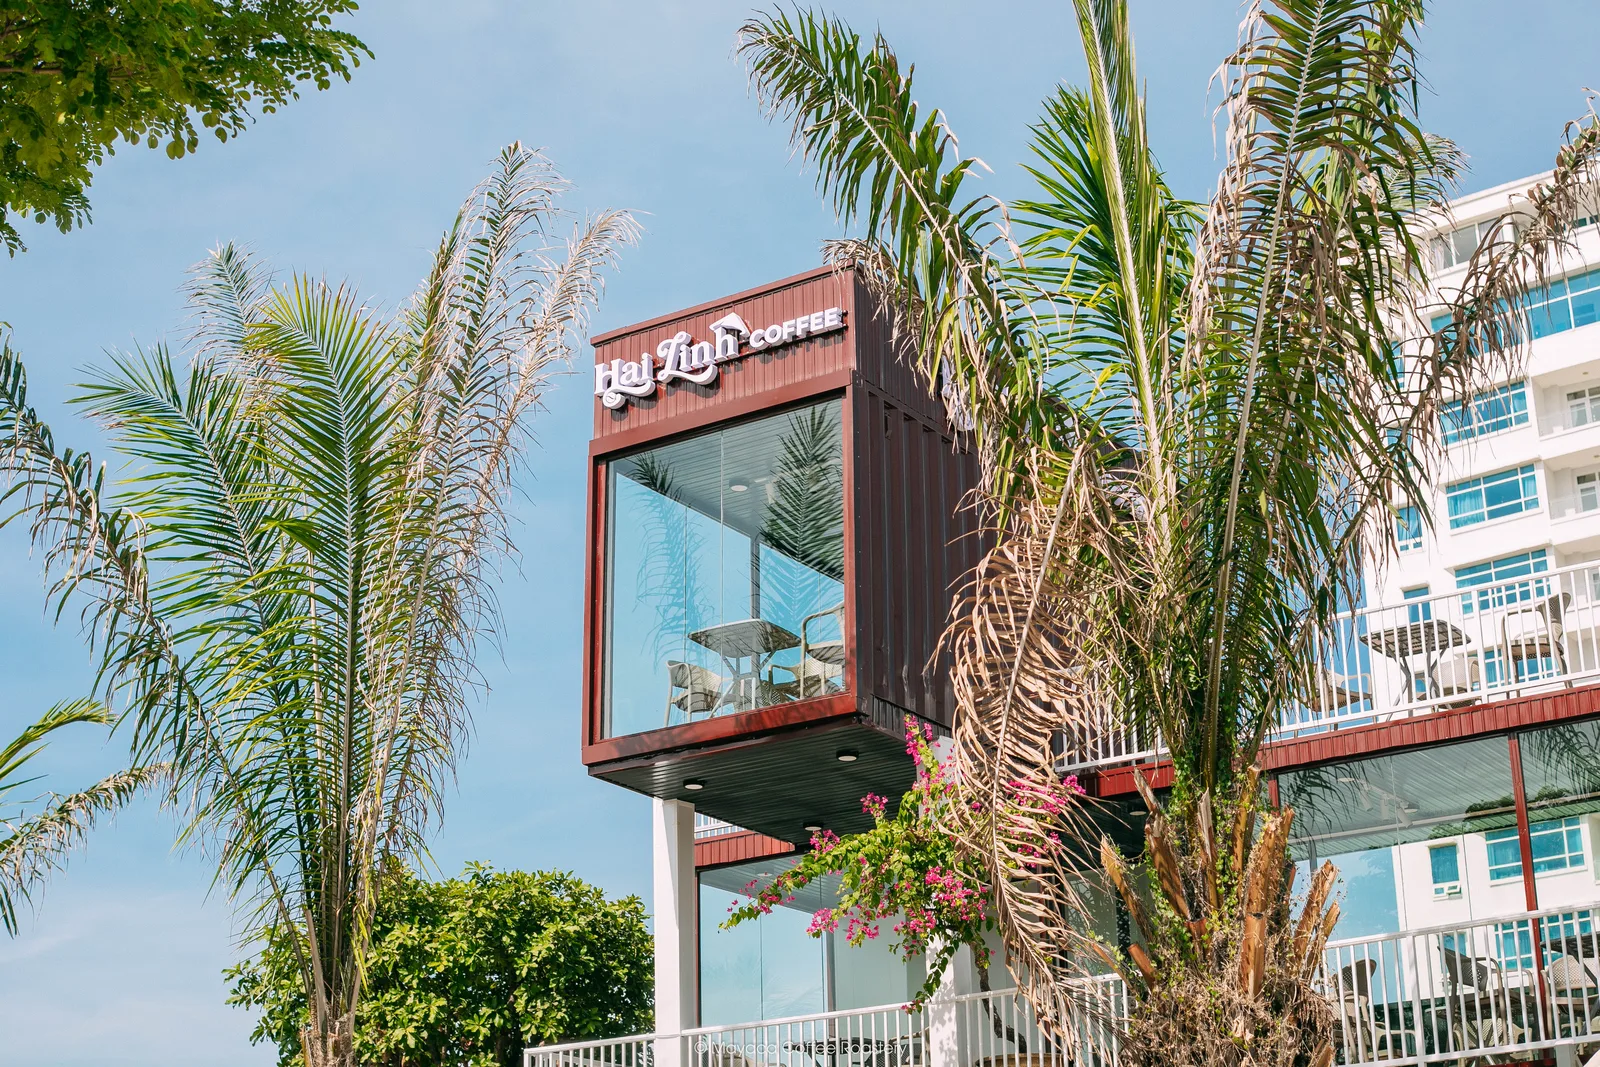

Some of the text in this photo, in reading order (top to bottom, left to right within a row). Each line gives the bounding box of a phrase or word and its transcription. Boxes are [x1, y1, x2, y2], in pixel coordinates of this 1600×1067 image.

[594, 307, 845, 409] Hai Linh COFFEE
